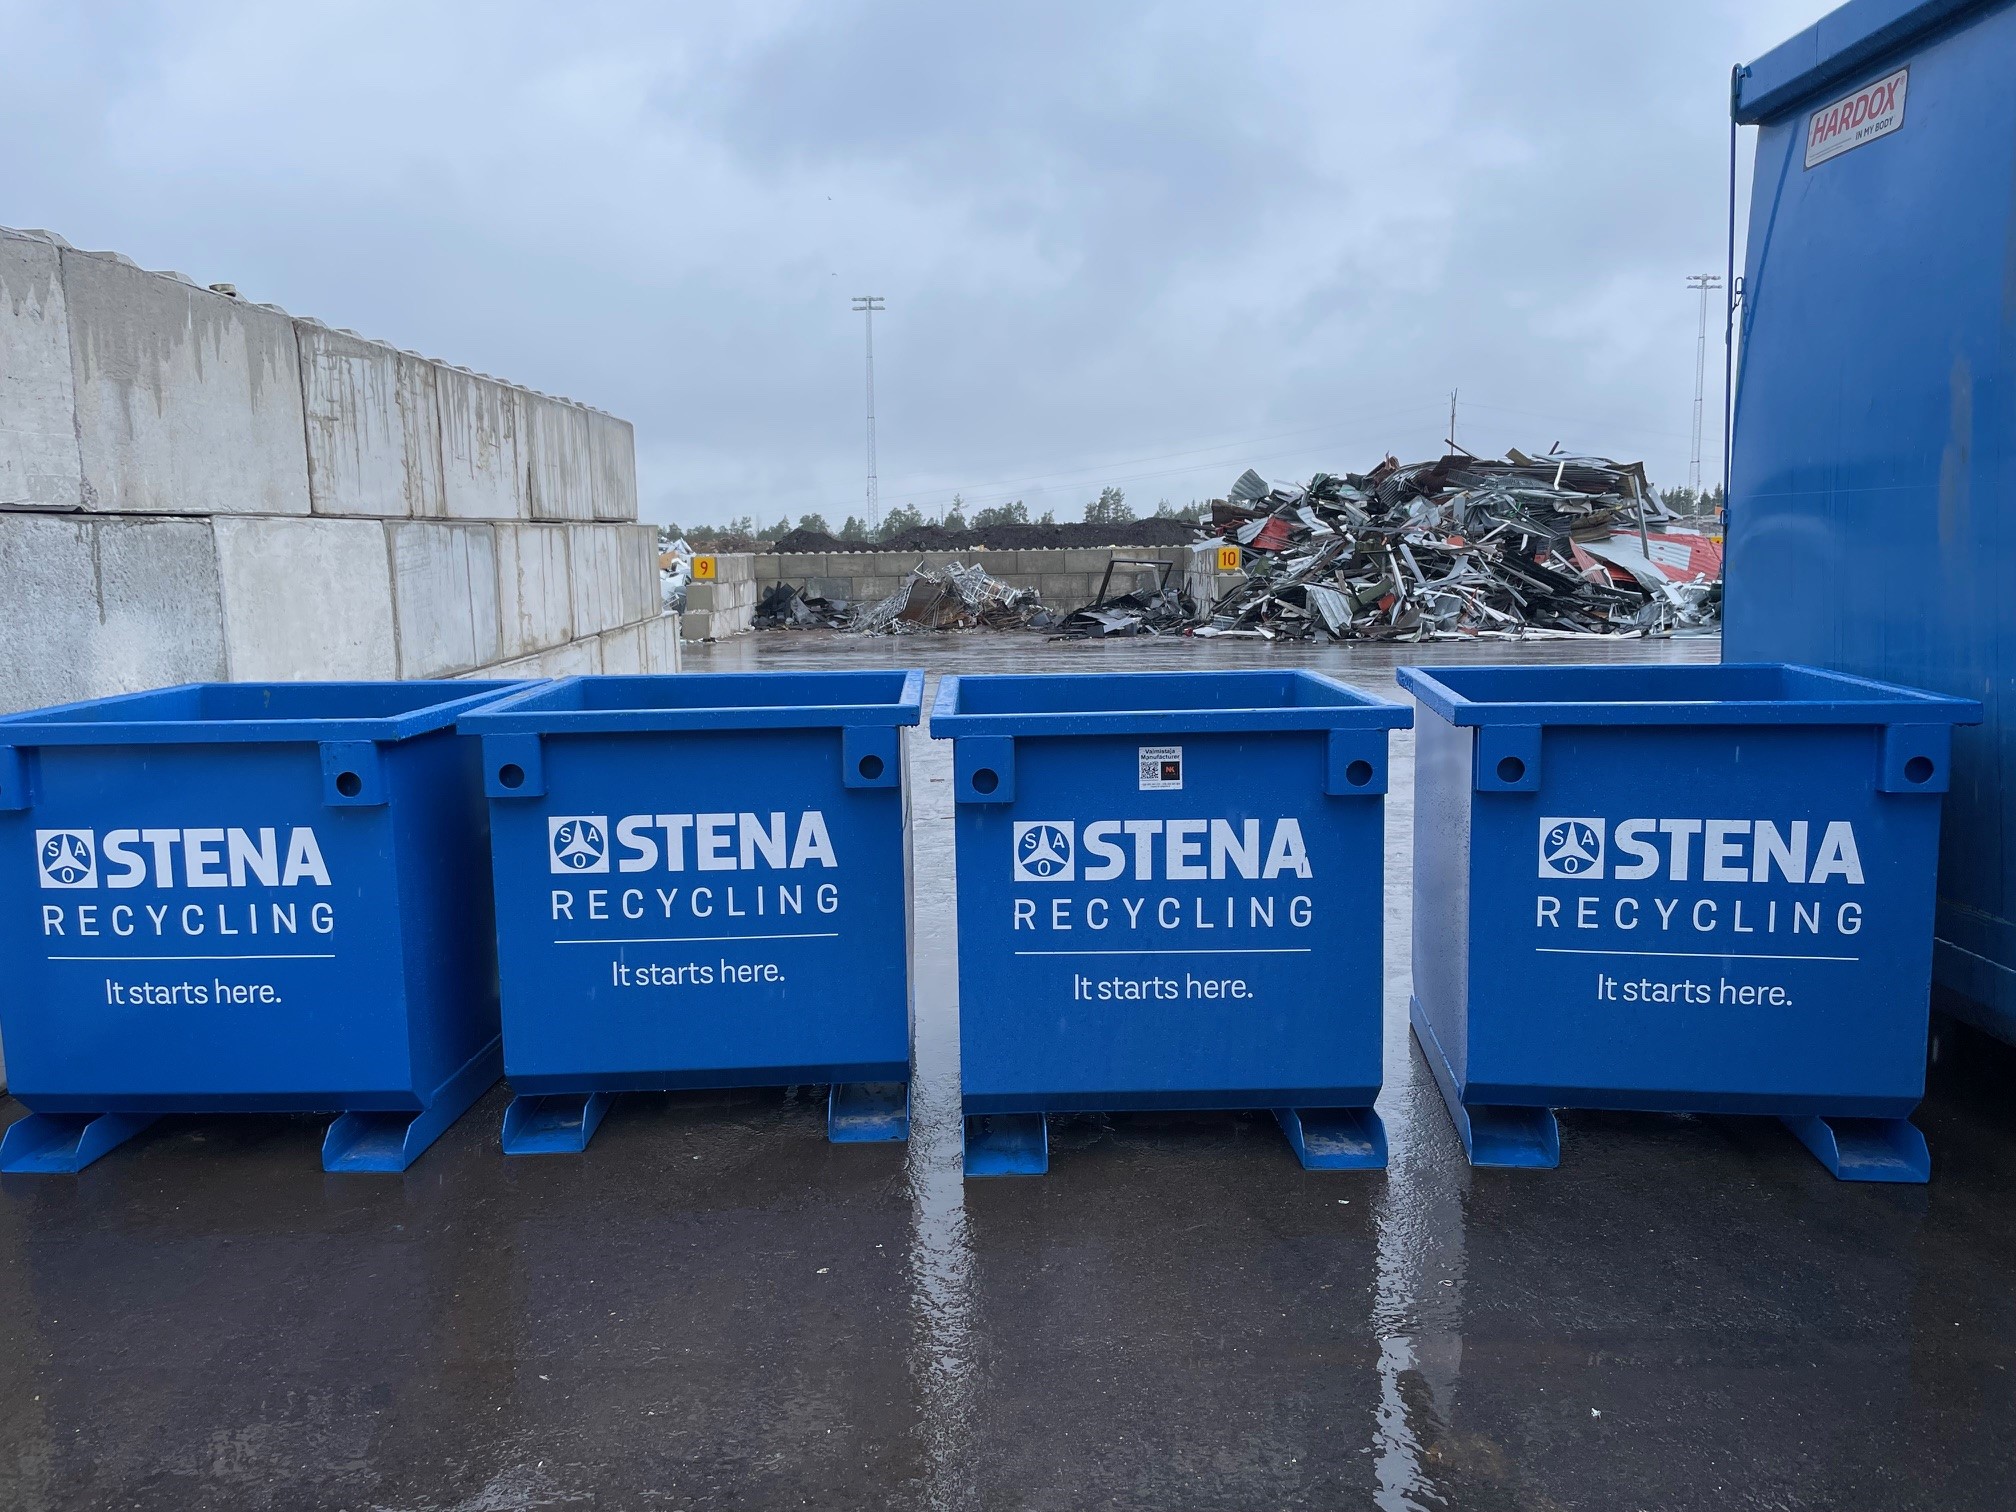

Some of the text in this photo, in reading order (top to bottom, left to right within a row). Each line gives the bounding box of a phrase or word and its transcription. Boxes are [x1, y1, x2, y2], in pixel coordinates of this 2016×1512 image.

[1855, 116, 1894, 141] IN MY BODY
[701, 561, 708, 575] 9
[1222, 551, 1236, 566] 10
[617, 811, 837, 872] STENA
[1084, 819, 1312, 881] STENA
[1615, 819, 1864, 884] STENA
[103, 828, 331, 888] STENA
[552, 884, 837, 919] RECYCLING
[1014, 896, 1311, 929] RECYCLING
[1537, 897, 1861, 934] RECYCLING
[43, 903, 333, 935] RECYCLING
[613, 959, 784, 986] It starts here.
[1075, 973, 1252, 1000] It starts here.
[107, 979, 281, 1005] It starts here.
[1599, 974, 1792, 1005] It starts here.
